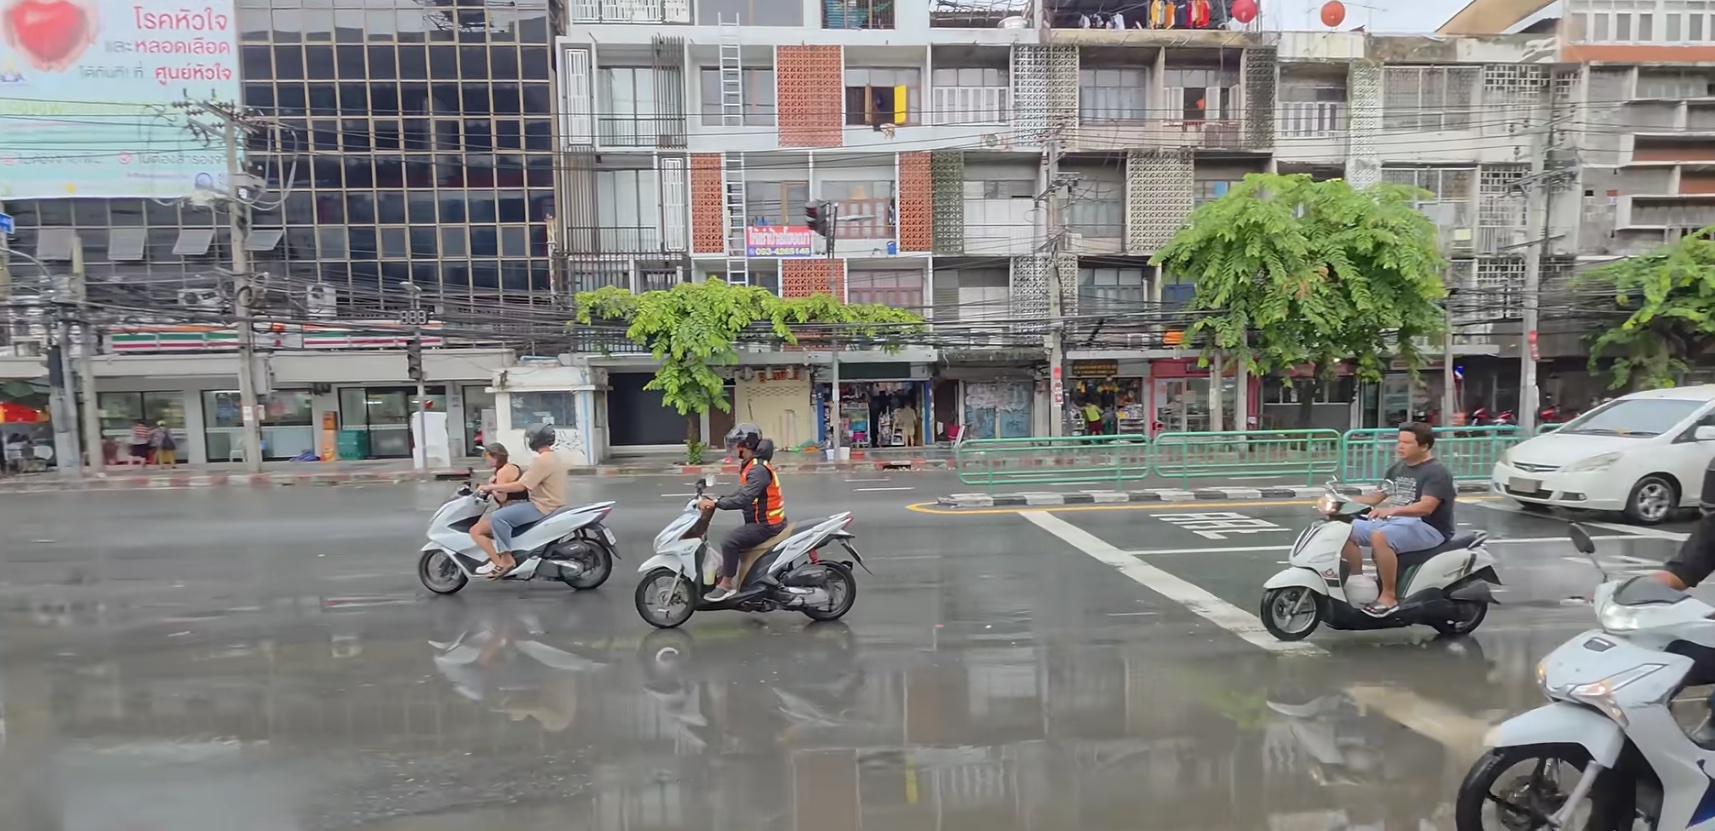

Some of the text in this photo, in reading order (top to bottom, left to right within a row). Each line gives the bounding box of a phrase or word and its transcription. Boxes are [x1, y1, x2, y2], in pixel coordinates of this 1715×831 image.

[134, 5, 228, 31] โรคหัวใจ
[155, 62, 232, 85] ศูนย์หัวใจ
